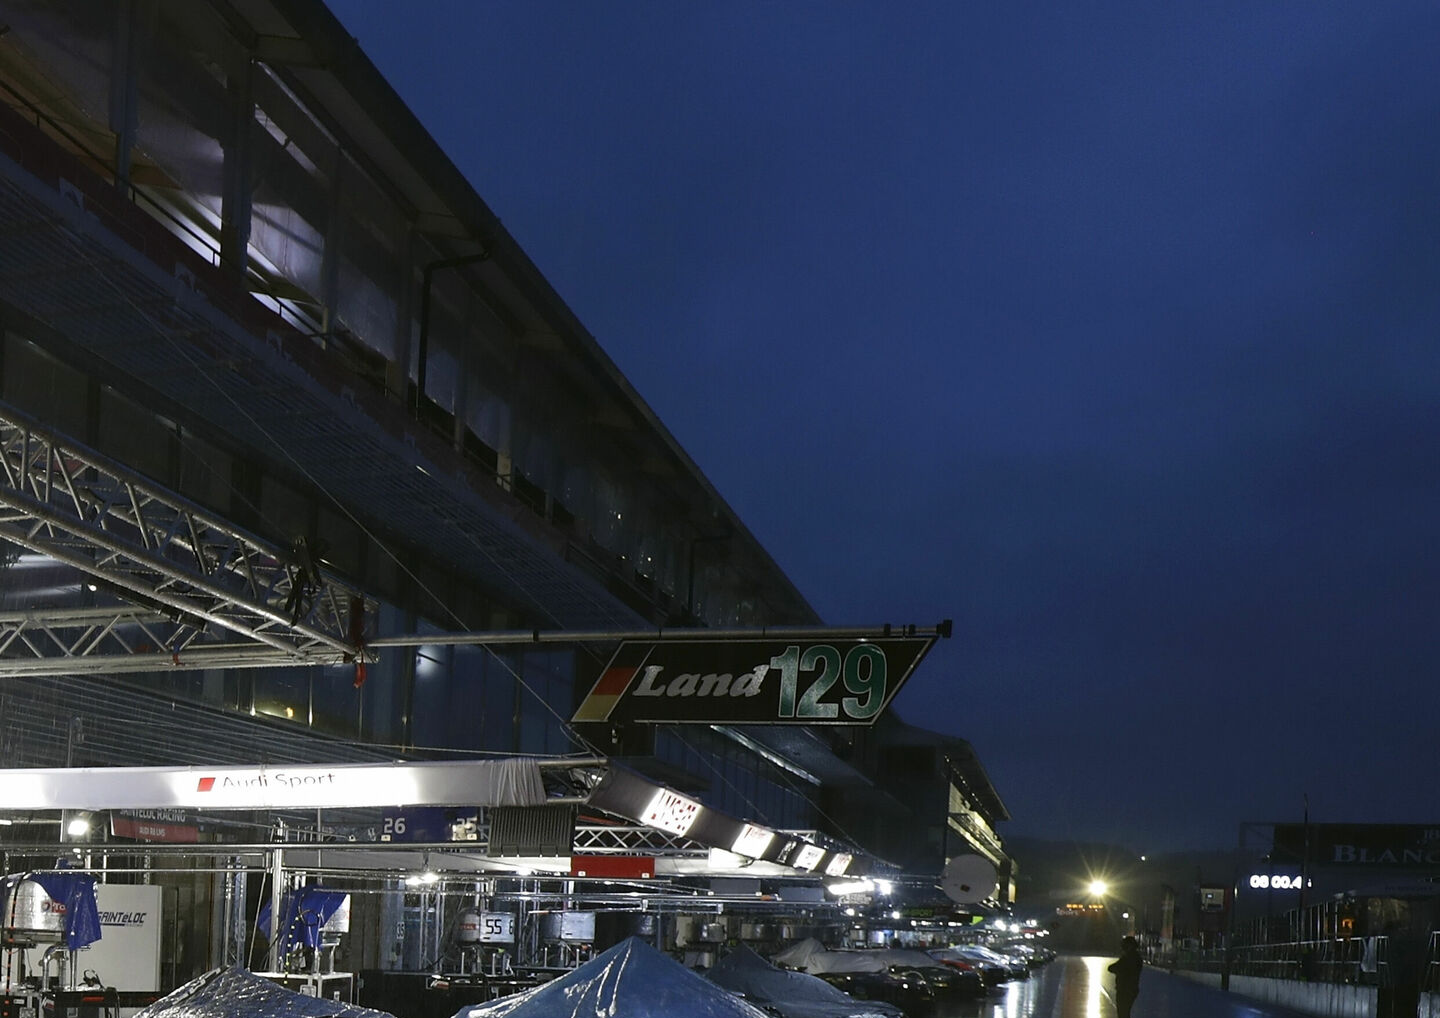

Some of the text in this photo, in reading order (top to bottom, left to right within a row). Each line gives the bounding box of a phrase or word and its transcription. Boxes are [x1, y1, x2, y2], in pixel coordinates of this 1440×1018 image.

[632, 664, 770, 698] Land
[771, 645, 887, 719] 129
[275, 773, 336, 788] Sport
[384, 818, 406, 834] 26
[486, 919, 502, 935] 55
